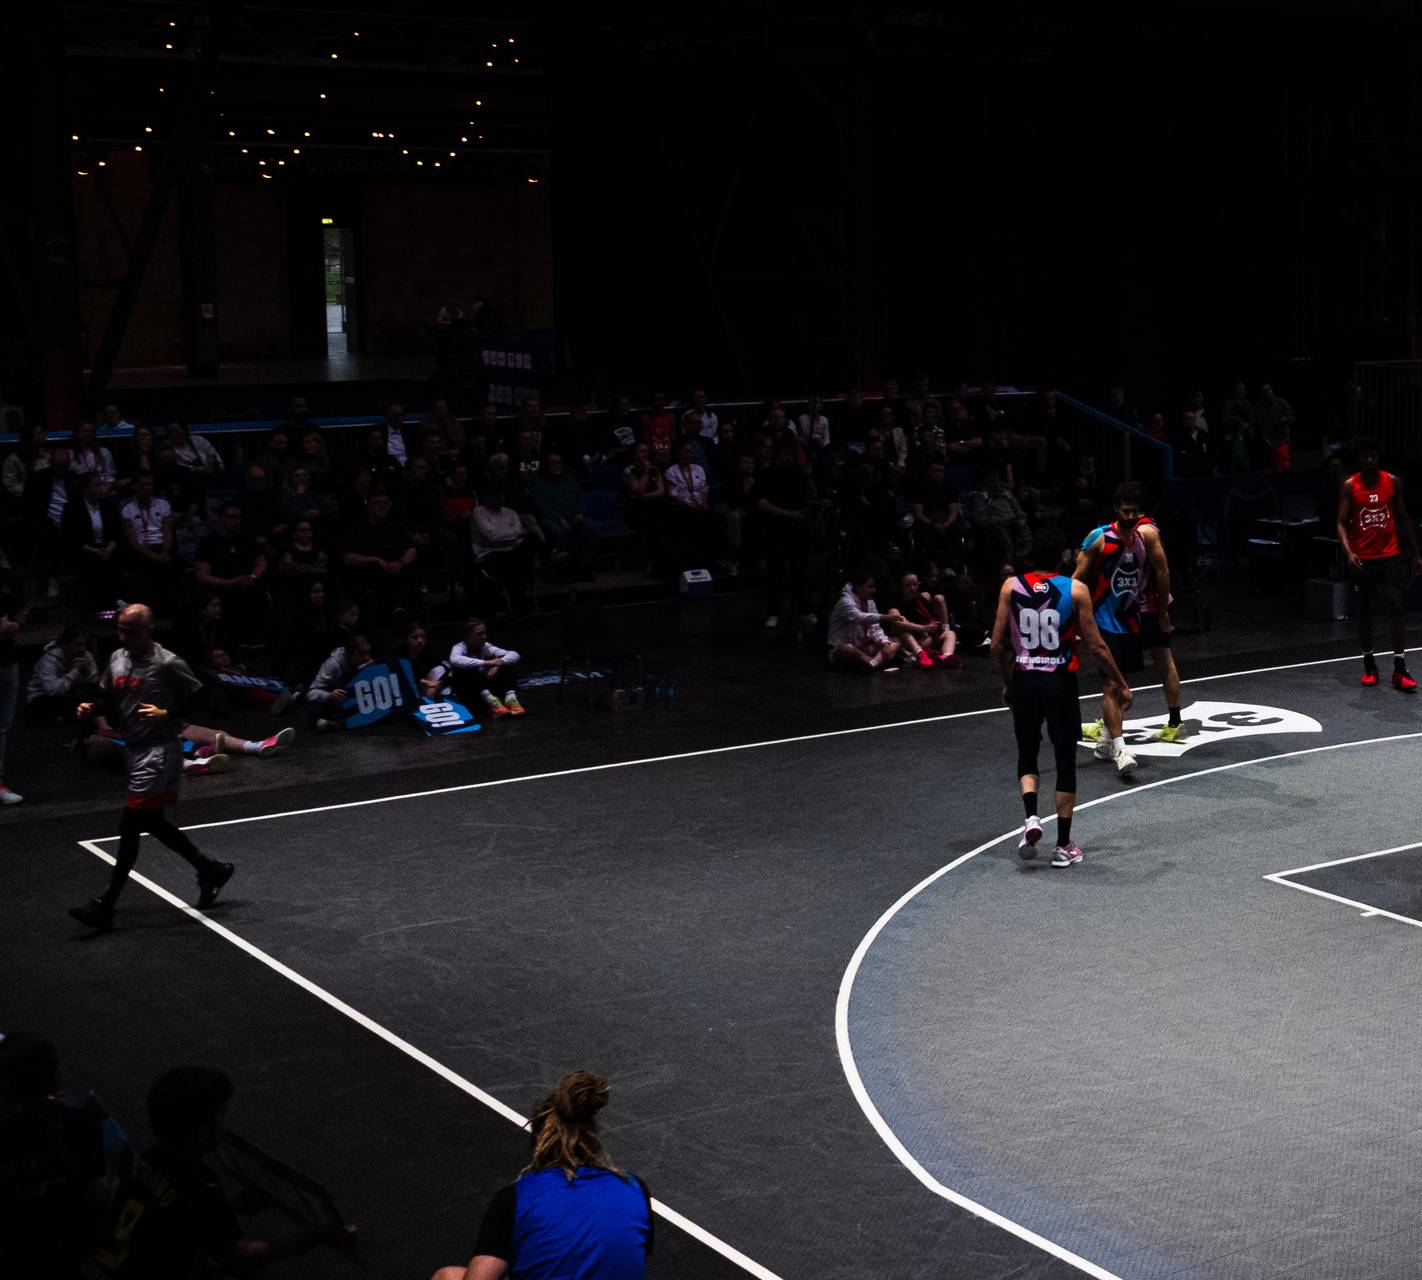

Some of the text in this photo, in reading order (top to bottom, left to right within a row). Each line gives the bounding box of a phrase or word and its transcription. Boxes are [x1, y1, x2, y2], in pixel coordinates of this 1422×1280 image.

[1019, 607, 1060, 651] 98
[354, 672, 403, 715] GO!
[418, 702, 465, 729] GO!
